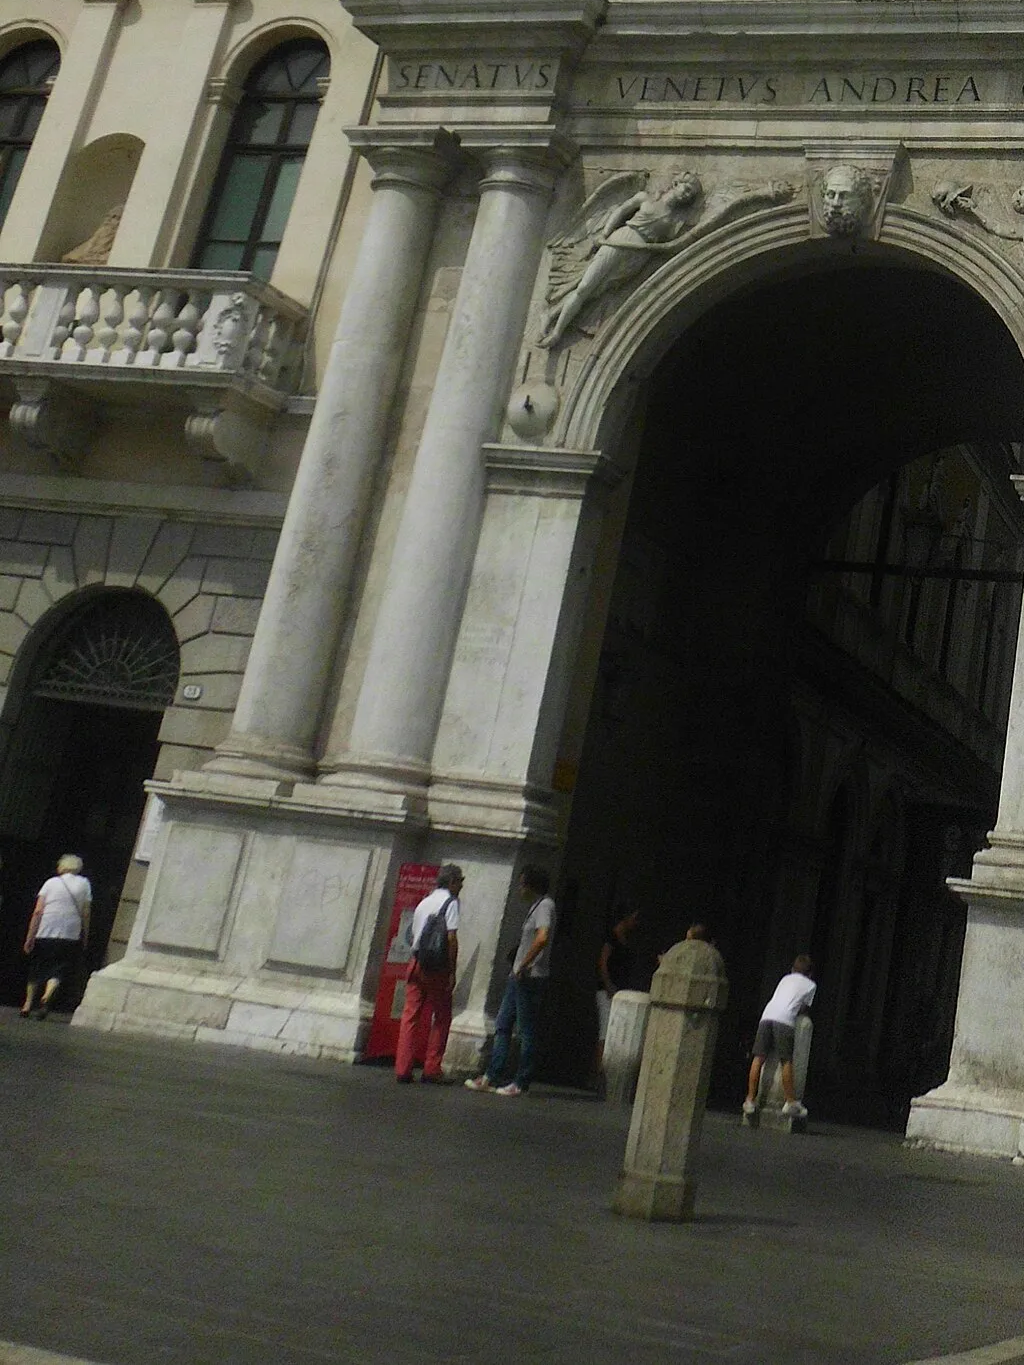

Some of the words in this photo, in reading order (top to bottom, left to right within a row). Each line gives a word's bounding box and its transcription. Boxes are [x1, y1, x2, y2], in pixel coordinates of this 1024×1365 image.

[396, 63, 552, 89] SENATVS
[615, 77, 779, 102] VENETVS
[808, 76, 981, 102] ANDREA
